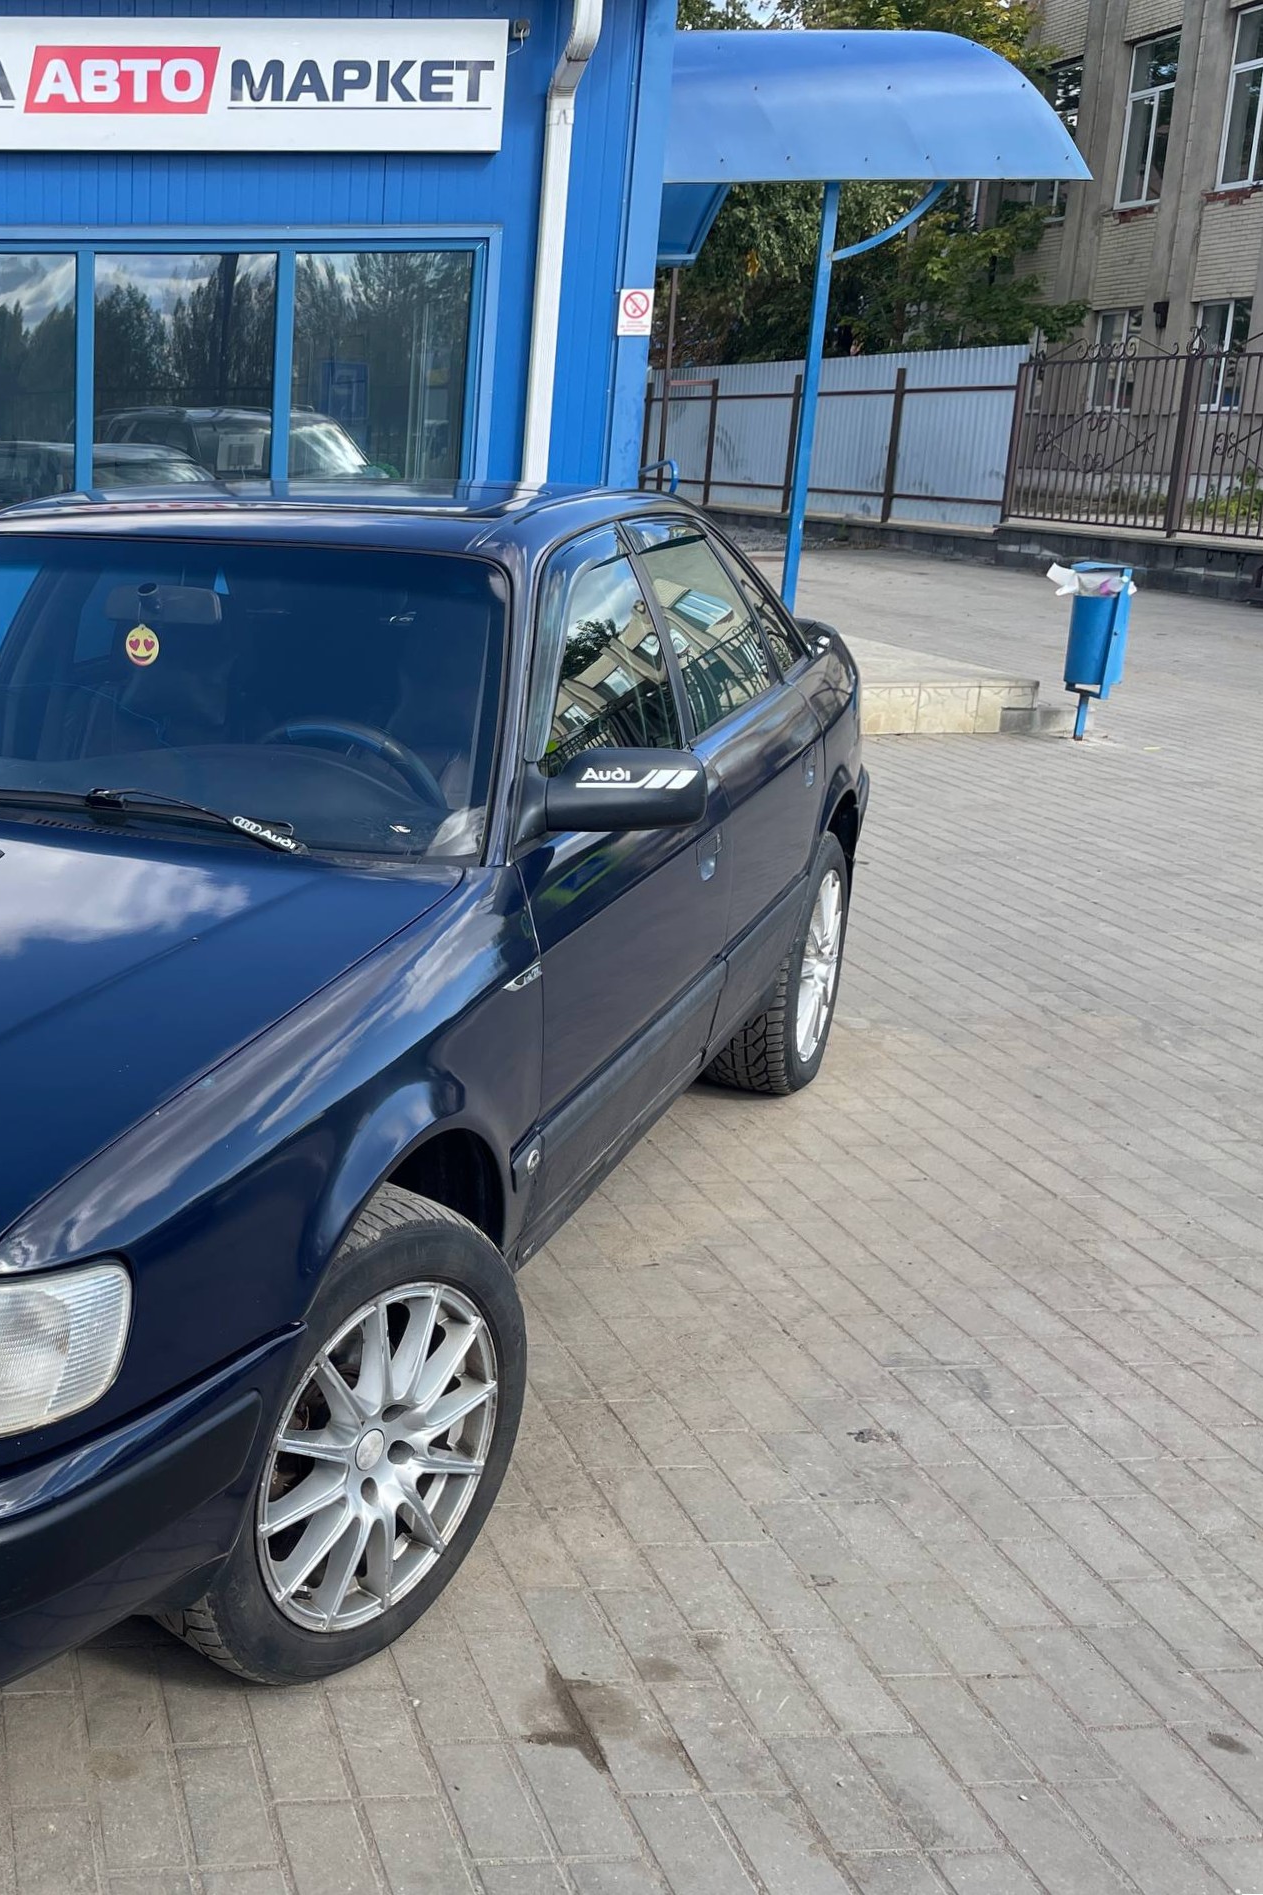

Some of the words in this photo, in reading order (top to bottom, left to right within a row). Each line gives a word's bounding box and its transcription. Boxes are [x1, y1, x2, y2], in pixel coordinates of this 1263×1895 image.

[33, 57, 206, 103] АВТО
[230, 59, 494, 103] МАРКЕТ
[581, 767, 631, 781] Audi
[259, 829, 296, 850] Audi
